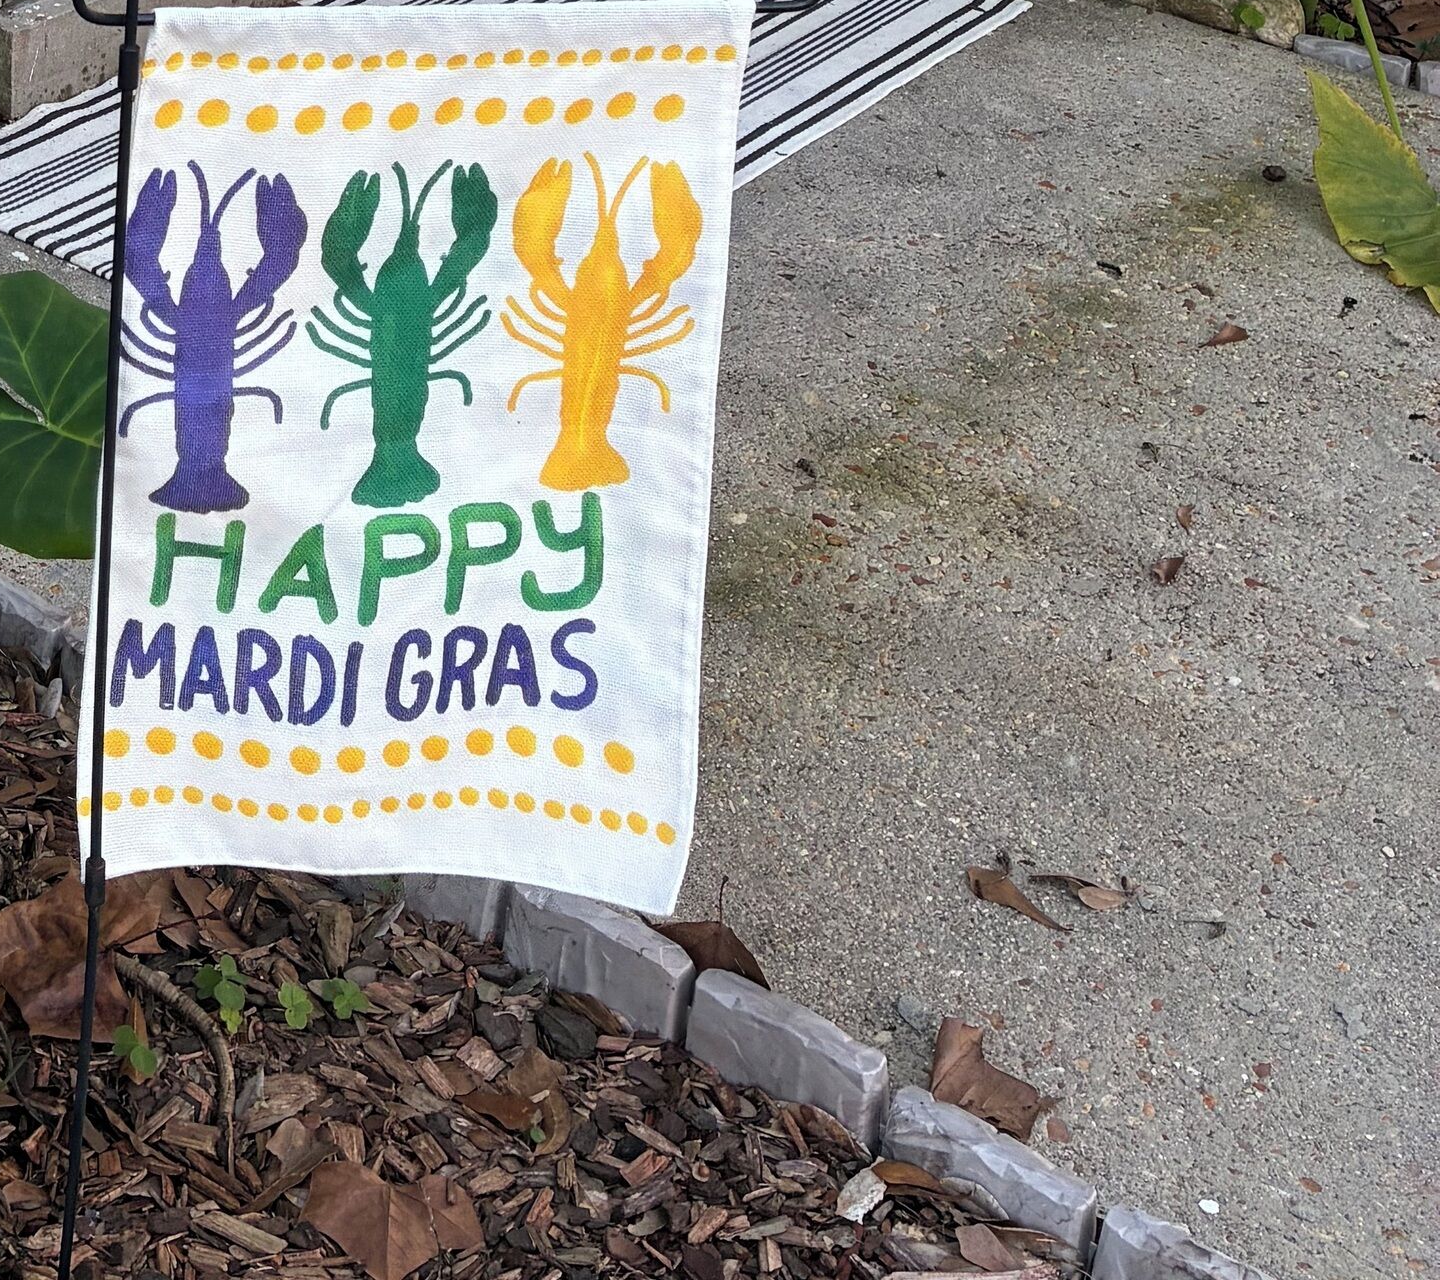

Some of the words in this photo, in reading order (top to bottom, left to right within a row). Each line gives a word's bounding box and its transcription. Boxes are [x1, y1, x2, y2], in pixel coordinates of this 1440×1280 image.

[149, 491, 604, 626] HAPPY
[110, 618, 363, 727] MARDI
[385, 618, 598, 722] GRAS
